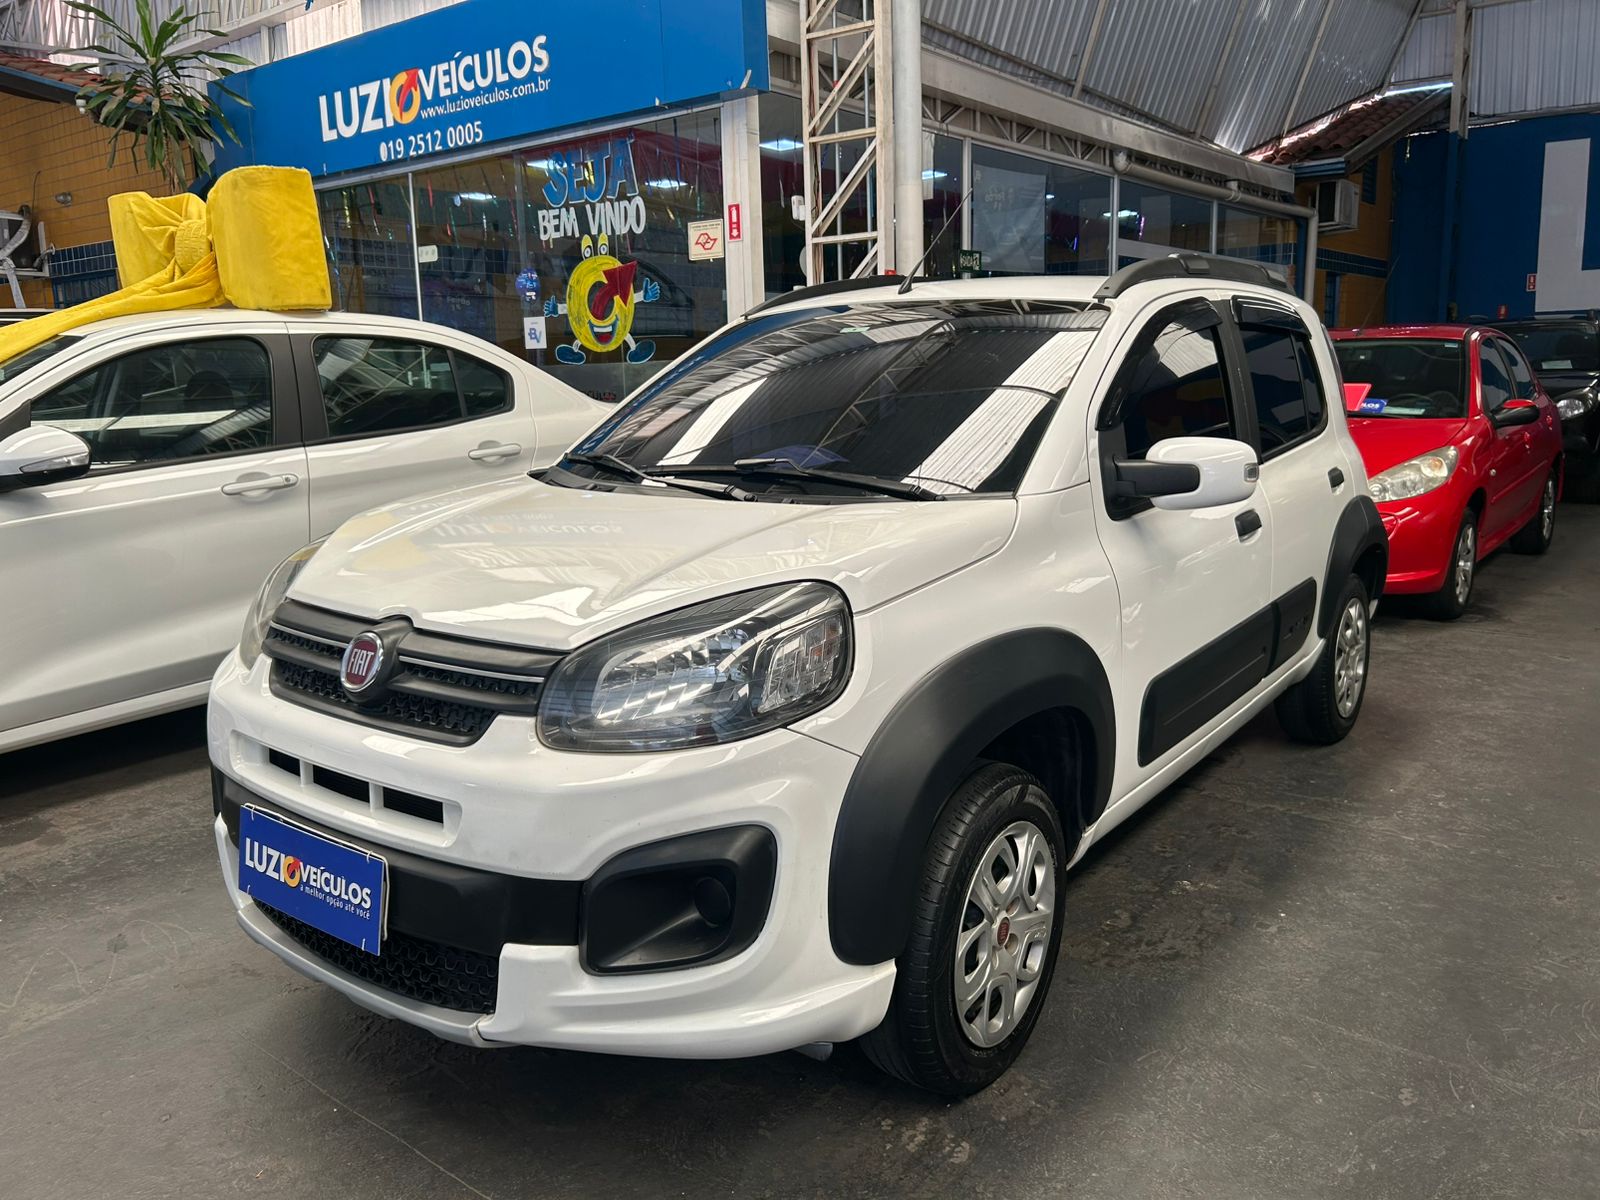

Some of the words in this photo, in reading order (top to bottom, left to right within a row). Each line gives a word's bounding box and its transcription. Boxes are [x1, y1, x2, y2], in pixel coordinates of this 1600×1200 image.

[319, 68, 421, 142] LUZIO
[418, 34, 549, 100] VEÍCULOS
[420, 76, 551, 120] www.luzioveiculos.com.br
[408, 129, 442, 156] 2512
[447, 121, 483, 147] 0005
[541, 137, 639, 207] SEJA
[538, 206, 580, 241] BEM
[585, 196, 647, 235] VINDO
[347, 648, 375, 677] FIAT
[245, 837, 301, 888] LUZIO
[300, 861, 372, 908] VEÍCULOS
[305, 884, 325, 901] melhor
[326, 894, 344, 909] opção
[345, 903, 355, 915] até
[356, 908, 371, 921] você
